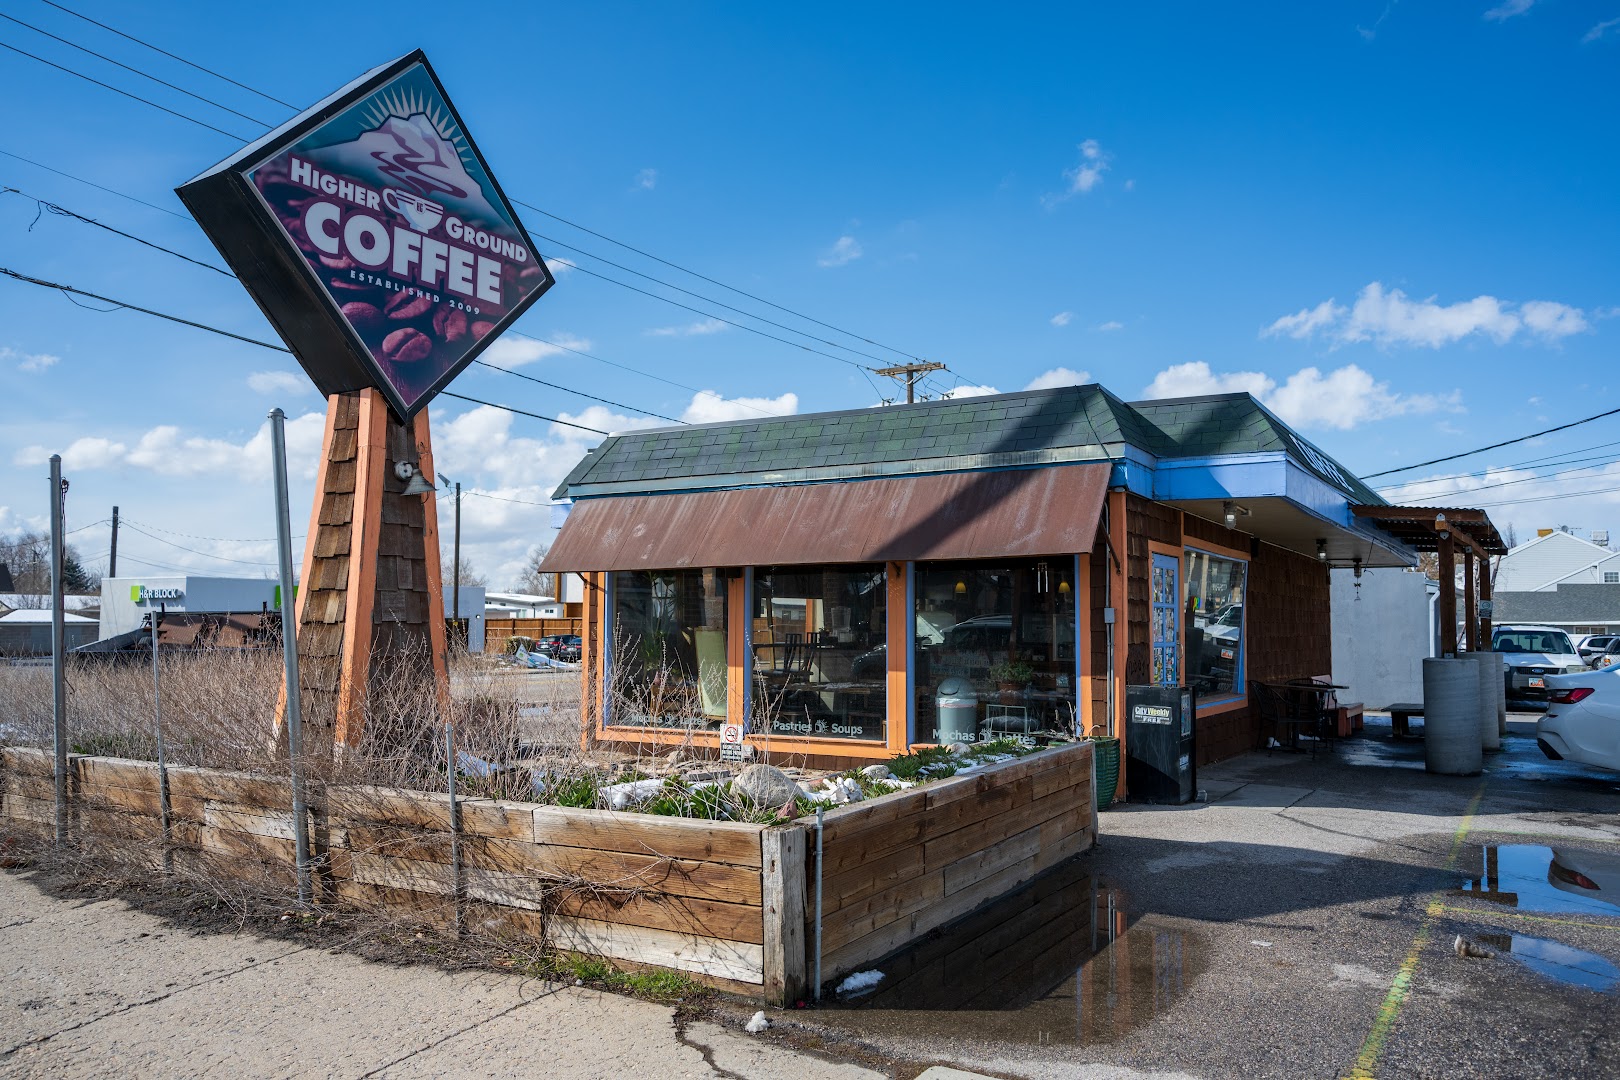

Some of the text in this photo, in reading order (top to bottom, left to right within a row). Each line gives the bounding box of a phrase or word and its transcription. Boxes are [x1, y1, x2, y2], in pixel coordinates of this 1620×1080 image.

[291, 158, 527, 263] HIGHER GROUND
[305, 202, 502, 305] COFFEE
[350, 270, 480, 315] ESTABLISHED 2009
[140, 589, 176, 598] H&R BLOCK
[1135, 706, 1148, 715] City
[1147, 707, 1170, 718] Weekly
[773, 720, 863, 736] Pastries Soups
[932, 728, 976, 742] Mochas
